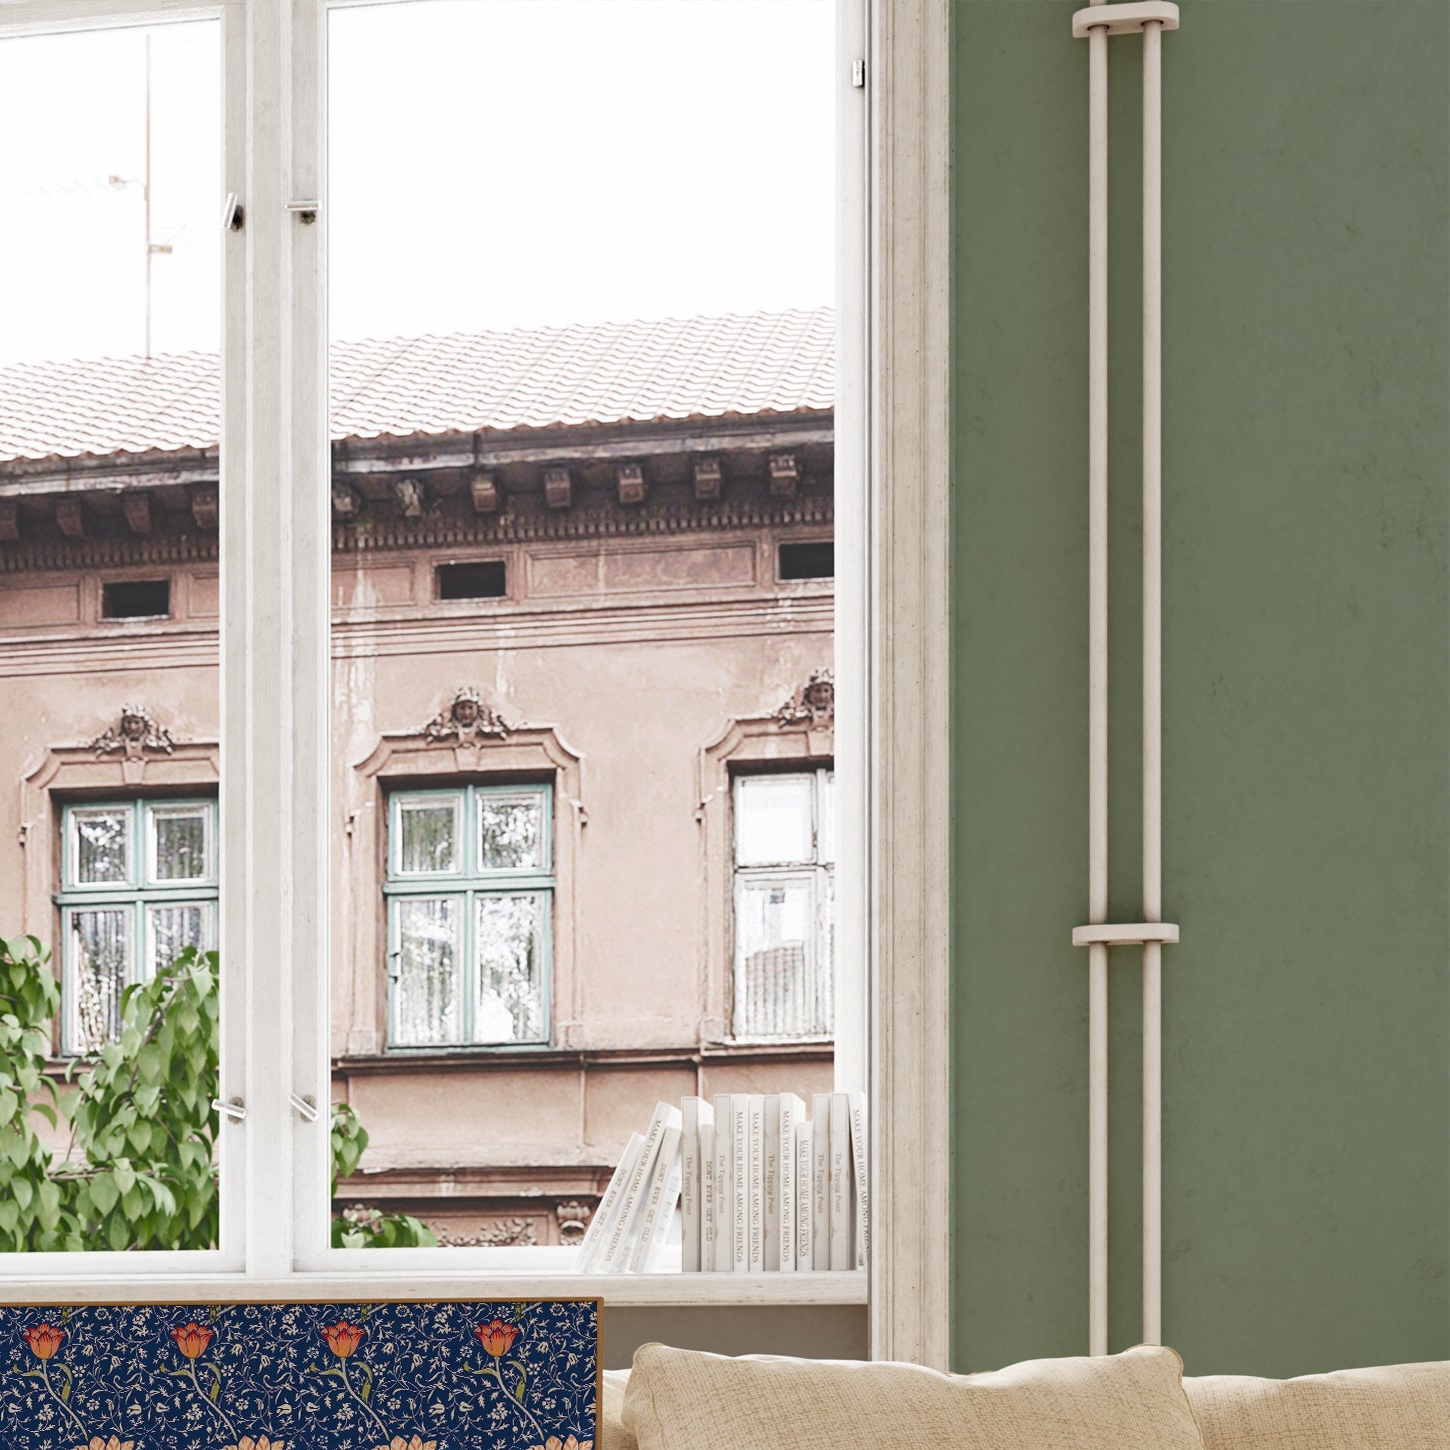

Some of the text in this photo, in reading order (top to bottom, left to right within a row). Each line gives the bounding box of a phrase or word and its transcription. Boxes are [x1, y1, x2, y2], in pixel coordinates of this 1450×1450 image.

[650, 1120, 662, 1144] MAKE
[855, 1137, 863, 1162] YOUR
[857, 1164, 866, 1188] HOME
[799, 1140, 809, 1256] MAKE YOUR HOME AMONG FRIENDS
[606, 1224, 623, 1263] FRIENDS
